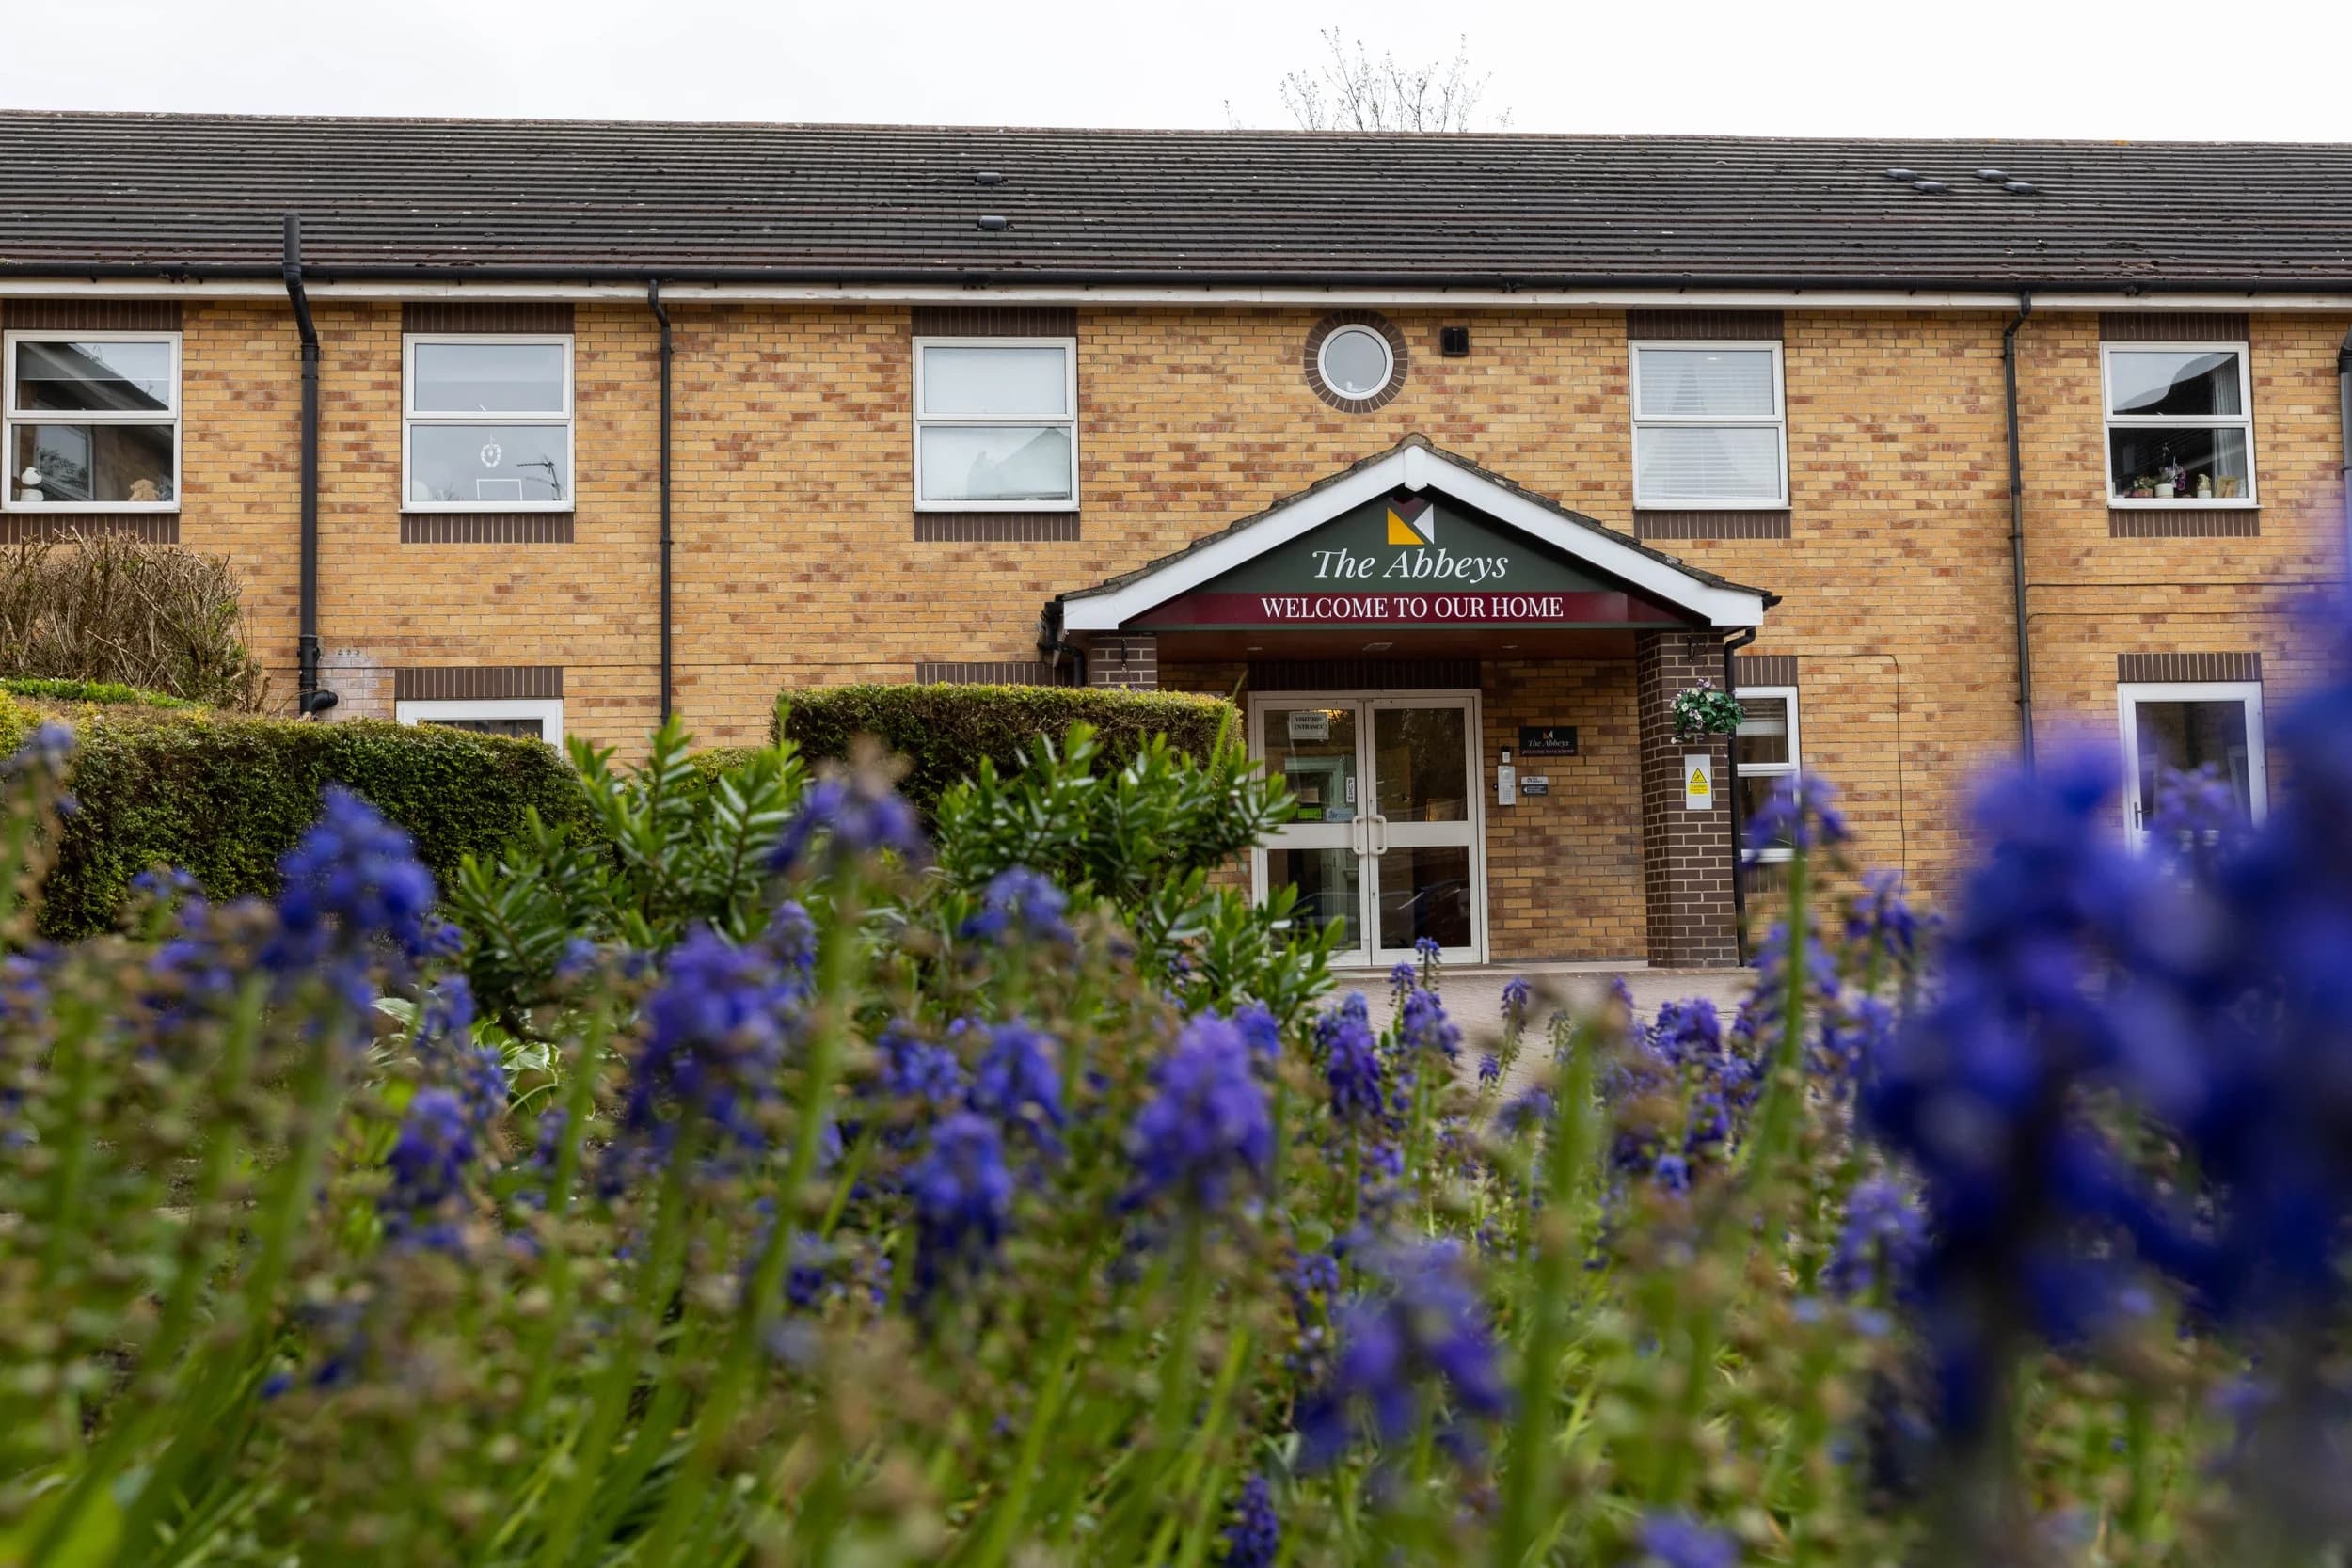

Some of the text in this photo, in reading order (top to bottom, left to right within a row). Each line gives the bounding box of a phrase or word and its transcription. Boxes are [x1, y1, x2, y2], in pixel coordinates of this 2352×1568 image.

[1311, 547, 1509, 584] The Abbeys
[1260, 596, 1564, 619] WELCOME TO OUR HOME
